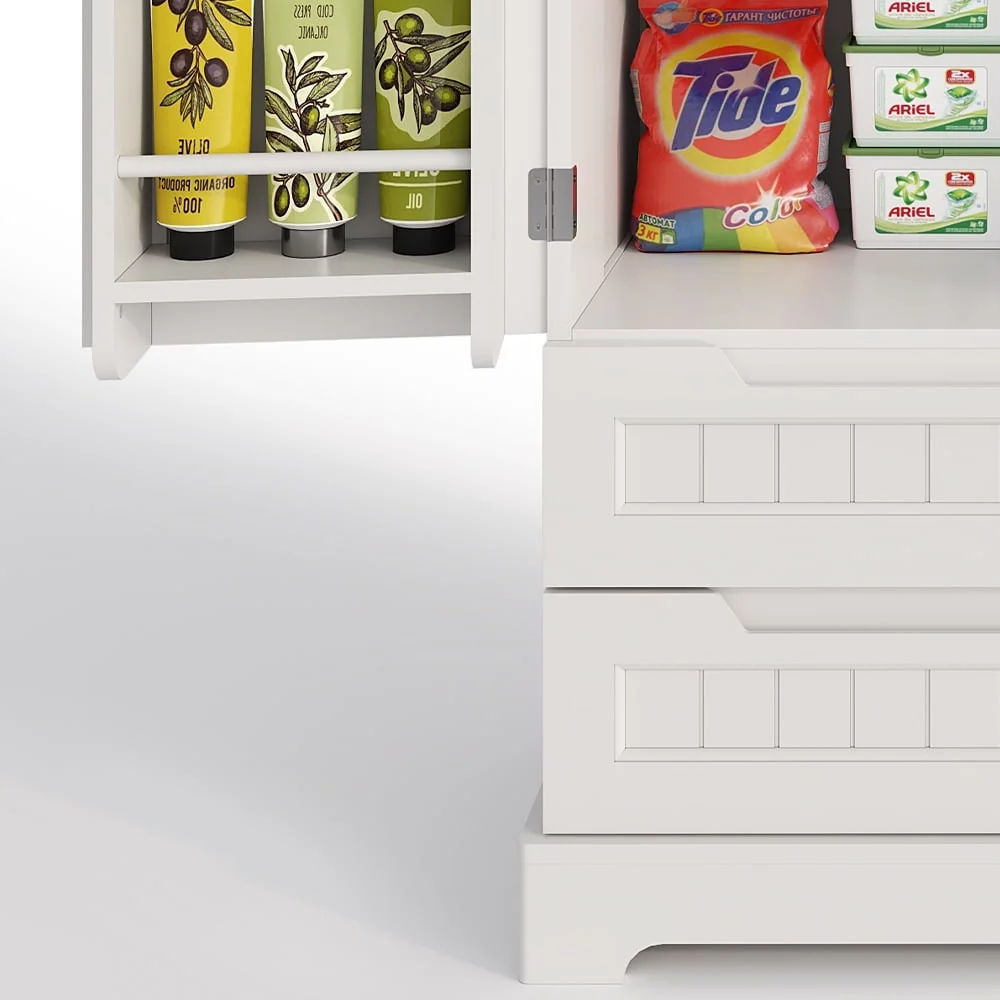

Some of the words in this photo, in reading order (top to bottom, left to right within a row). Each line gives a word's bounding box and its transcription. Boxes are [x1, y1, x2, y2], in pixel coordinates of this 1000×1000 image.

[725, 12, 764, 22] ГАРАНТ
[767, 8, 818, 20] ЧИСТОТЫ
[671, 51, 802, 153] Tide
[640, 213, 676, 229] АВТОМАТ
[637, 224, 645, 236] 3
